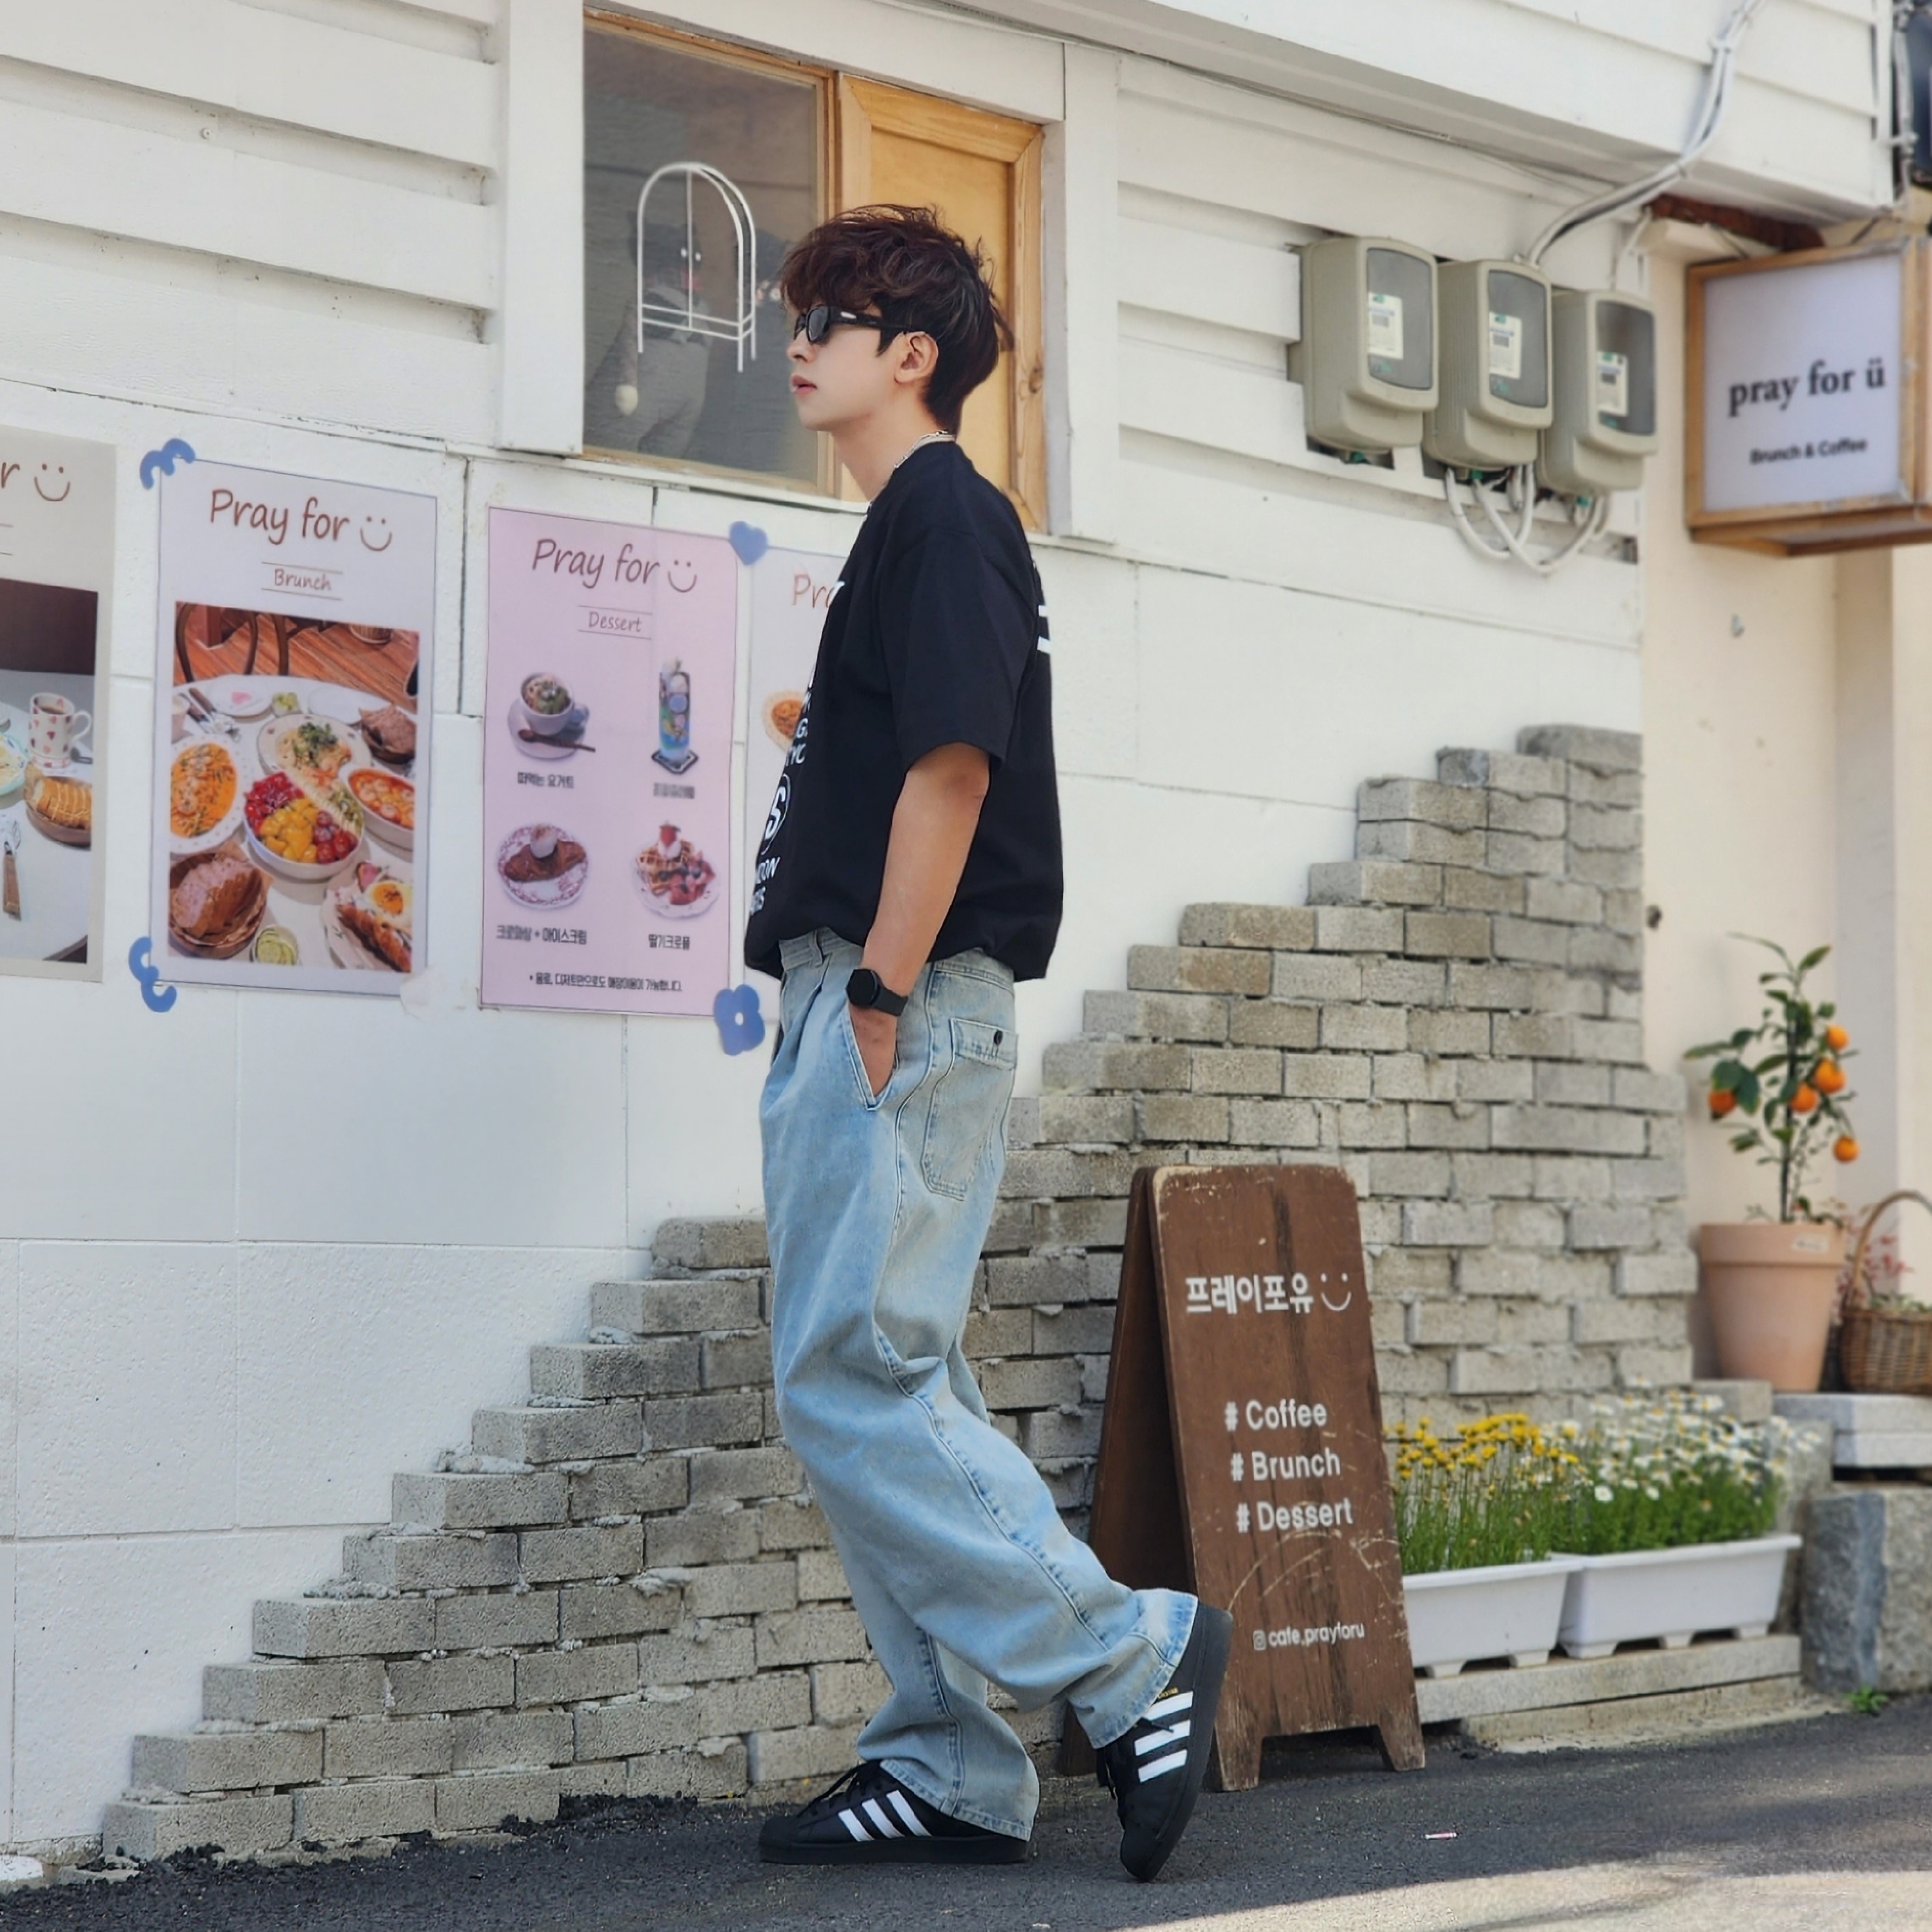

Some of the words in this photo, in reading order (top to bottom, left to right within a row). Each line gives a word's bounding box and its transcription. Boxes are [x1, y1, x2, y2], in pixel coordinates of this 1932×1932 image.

[1727, 375, 1799, 418] pray
[1808, 359, 1855, 395] for
[1865, 357, 1886, 390] ü
[1749, 445, 1802, 465] Brunch
[1804, 444, 1815, 458] &
[1817, 438, 1867, 457] Coffee
[210, 489, 289, 545] Pray
[301, 496, 350, 541] for
[274, 568, 332, 592] Brunch
[532, 538, 605, 589] Pray
[614, 543, 660, 584] for
[588, 611, 642, 633] Dessert
[542, 927, 588, 945] 아이스크림
[1185, 1272, 1314, 1315] 프레이포유
